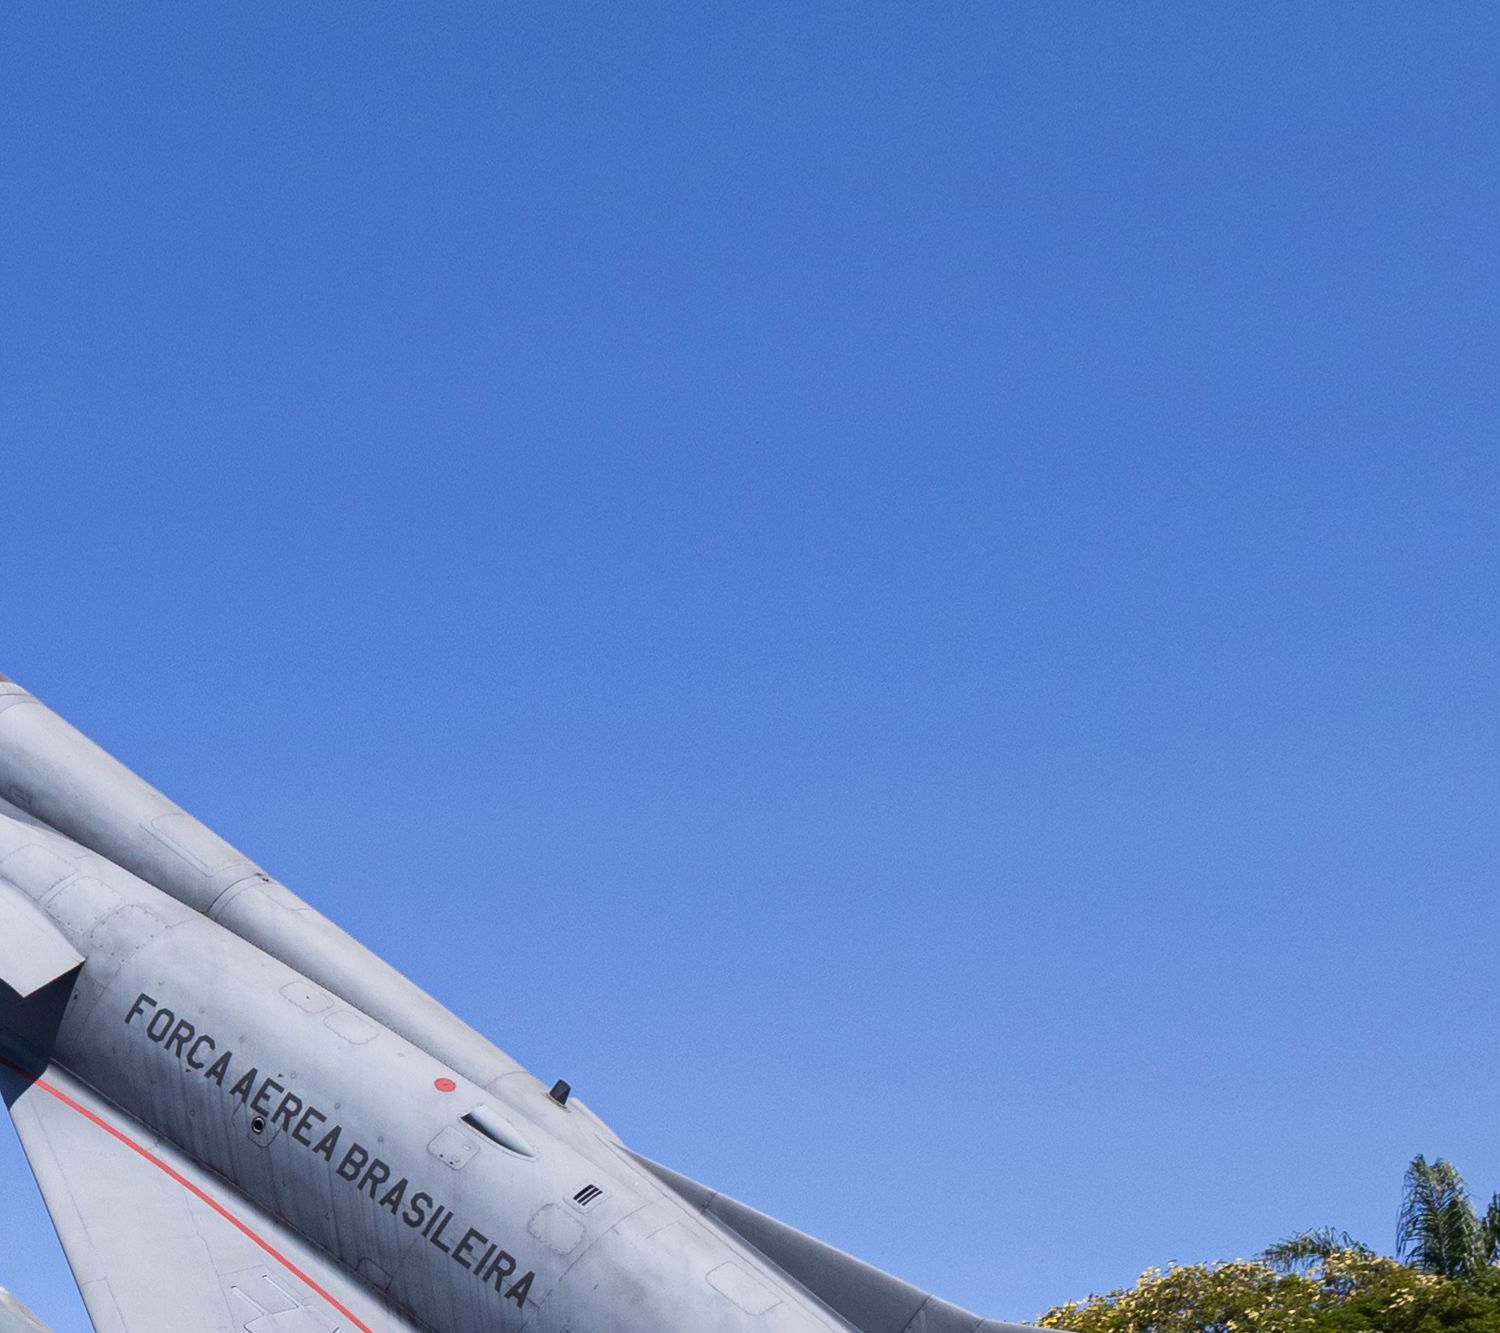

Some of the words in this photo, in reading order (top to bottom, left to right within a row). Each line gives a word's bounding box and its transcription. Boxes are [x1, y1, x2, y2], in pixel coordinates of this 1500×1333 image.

[124, 992, 234, 1087] FORÇA
[229, 1067, 343, 1163] AÉREA
[336, 1142, 536, 1310] BRASILEIRA
